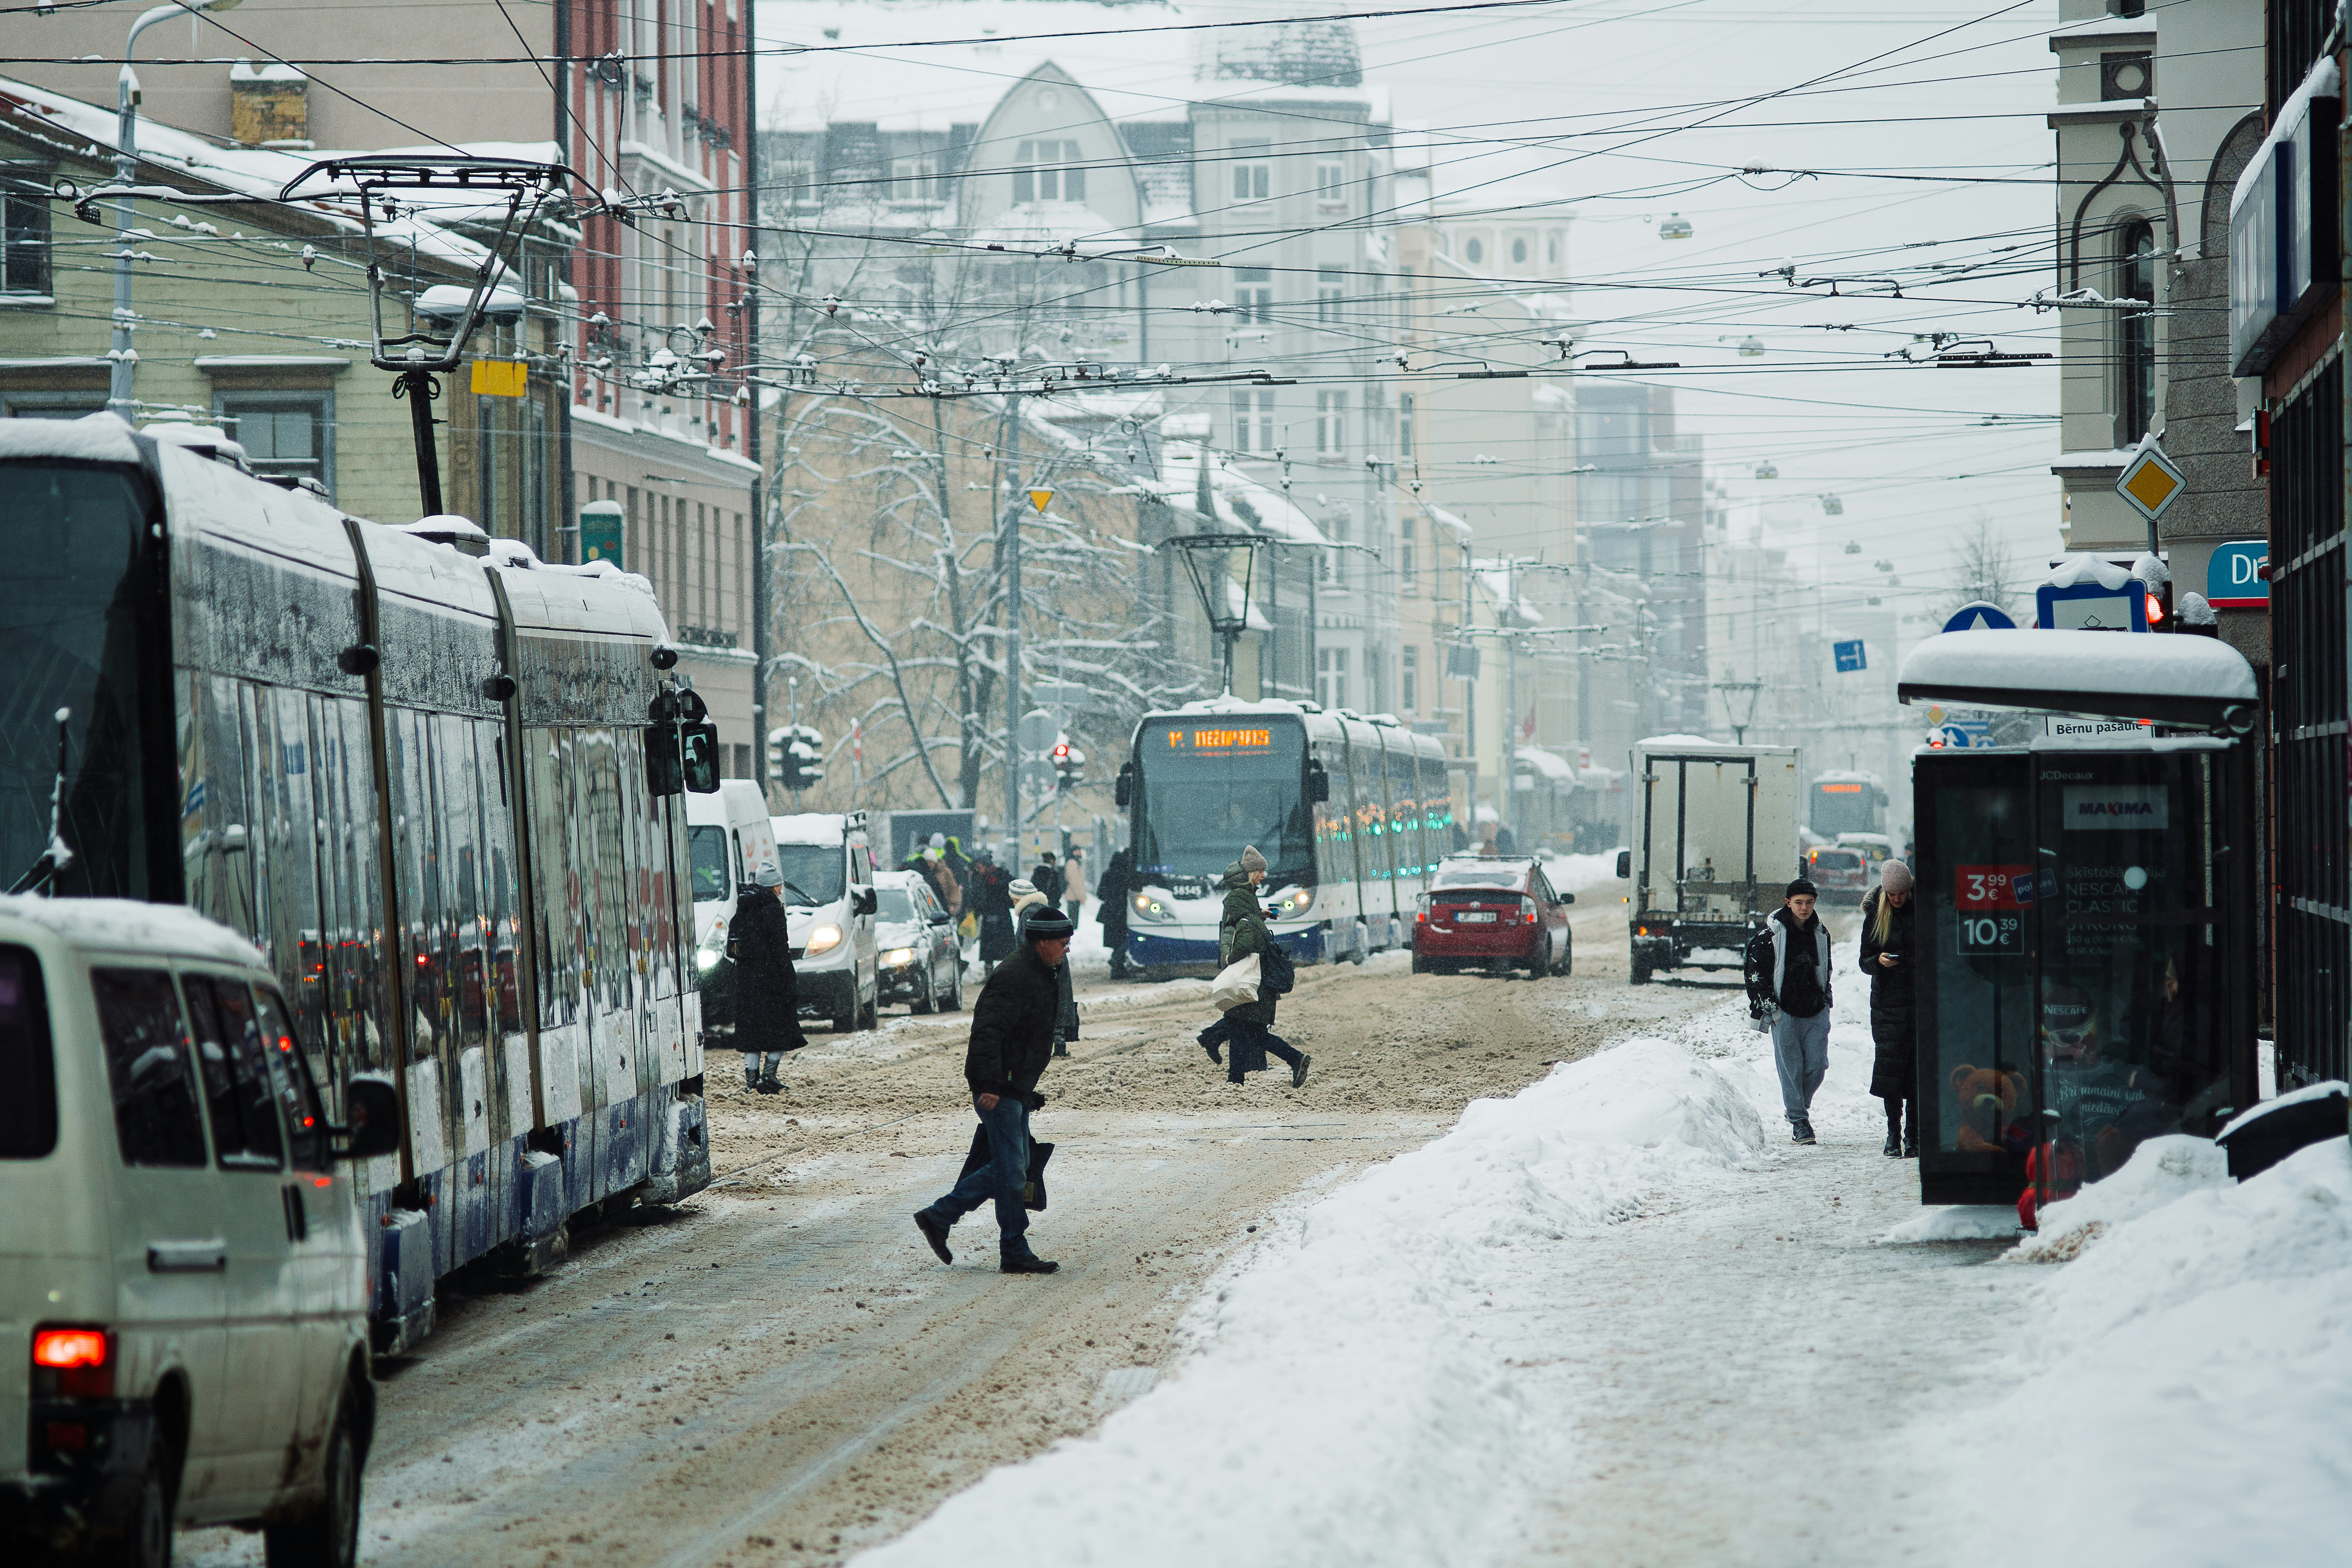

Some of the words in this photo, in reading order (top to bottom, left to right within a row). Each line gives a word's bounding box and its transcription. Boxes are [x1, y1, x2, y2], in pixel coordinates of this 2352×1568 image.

[2056, 724, 2092, 735] Bērnu
[2040, 770, 2094, 780] JCDecaux
[2079, 800, 2154, 817] MAXIMA
[1967, 874, 1986, 901] 3
[1988, 874, 2007, 886] 99
[1988, 889, 1998, 900] €
[2066, 900, 2138, 913] CLASIC
[1964, 918, 1998, 945] 10
[2000, 918, 2018, 931] 39
[2000, 933, 2010, 945] €
